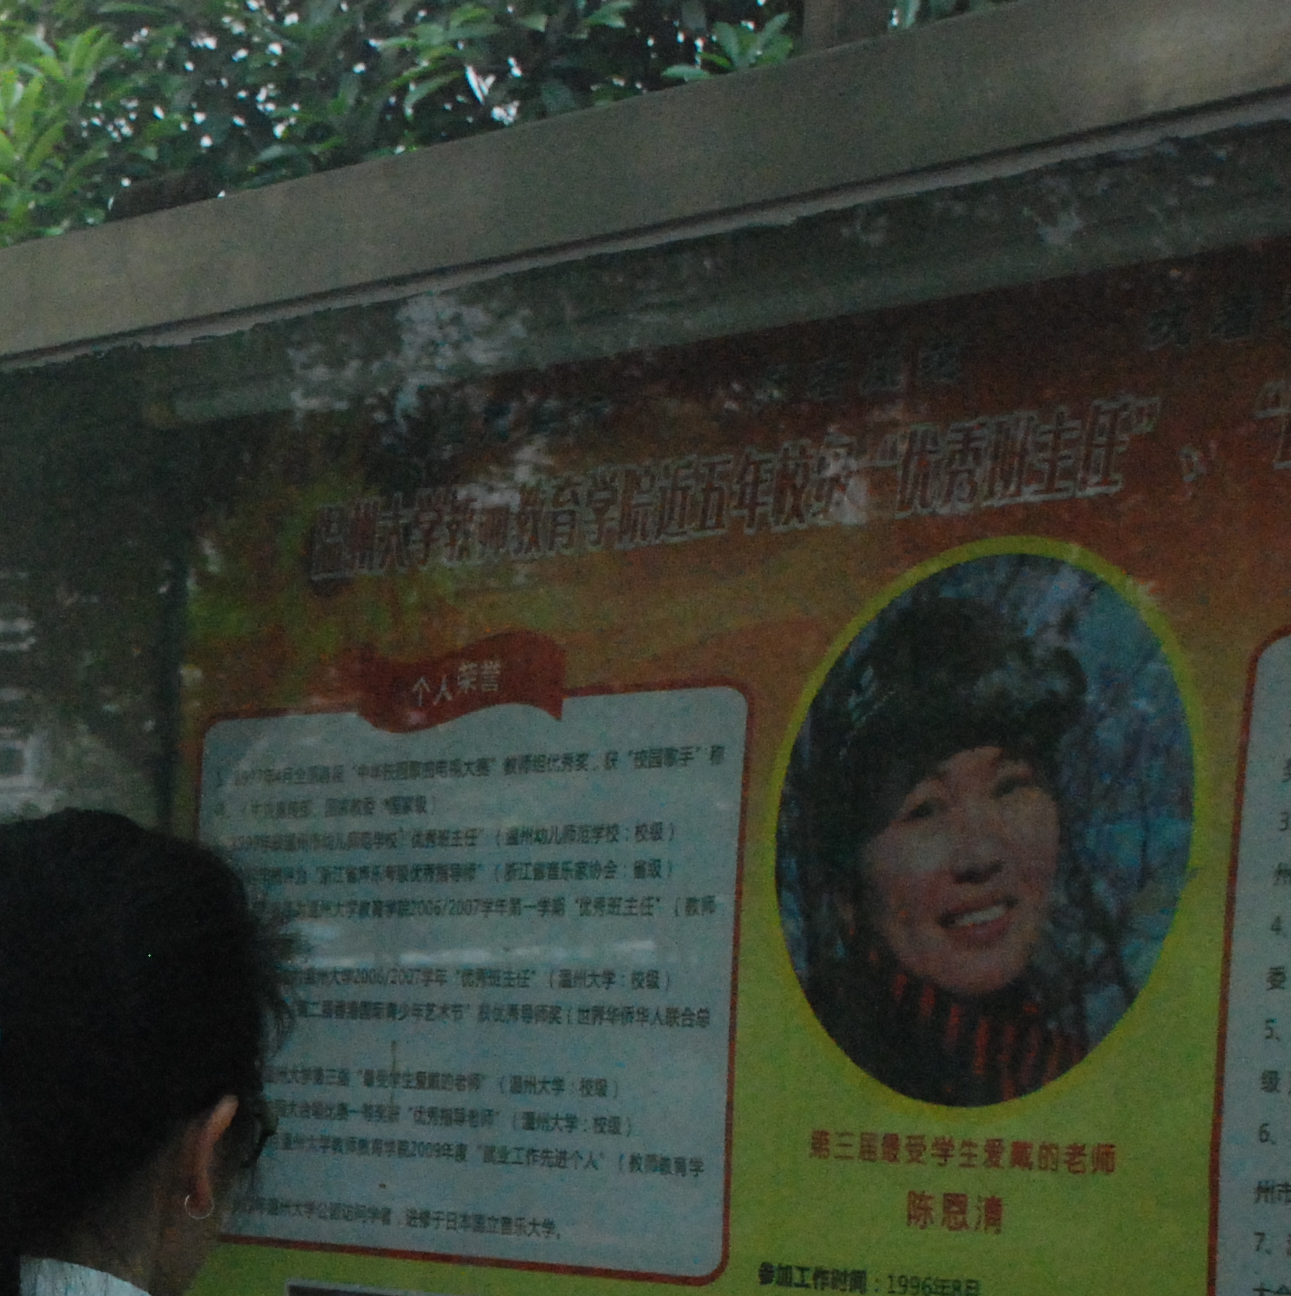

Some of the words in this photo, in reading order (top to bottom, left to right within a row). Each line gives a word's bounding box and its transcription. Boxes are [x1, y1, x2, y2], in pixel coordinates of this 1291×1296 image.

[411, 659, 502, 707] 个人荣誉
[809, 1130, 1117, 1174] 第三届最受学生爱戴的老师
[907, 1190, 1004, 1234] 陈恩清
